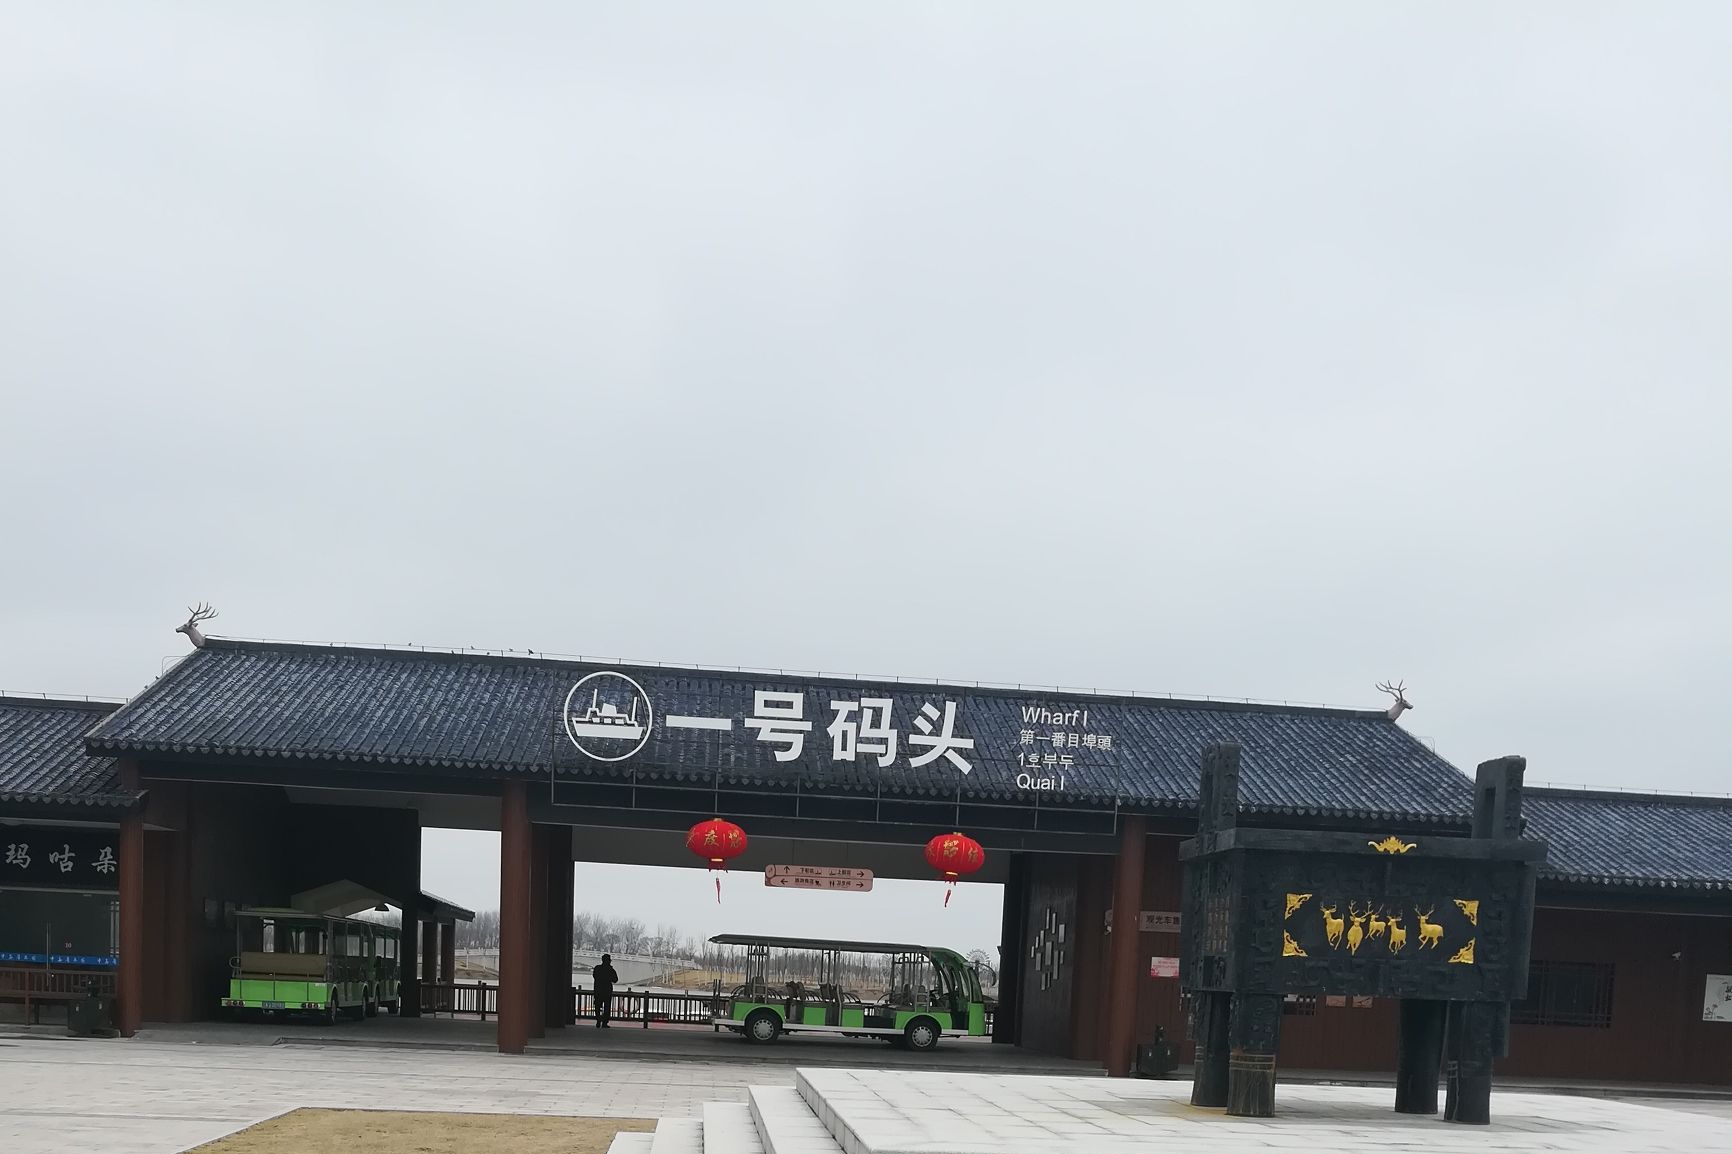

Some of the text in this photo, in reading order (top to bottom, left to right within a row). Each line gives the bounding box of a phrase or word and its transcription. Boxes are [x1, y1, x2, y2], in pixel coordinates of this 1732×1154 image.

[1021, 706, 1080, 726] Wharf
[665, 689, 974, 775] 一号码头
[1020, 728, 1112, 750] 第一番目埠頭
[1018, 752, 1074, 770] 1호부두
[1016, 773, 1055, 790] Quai
